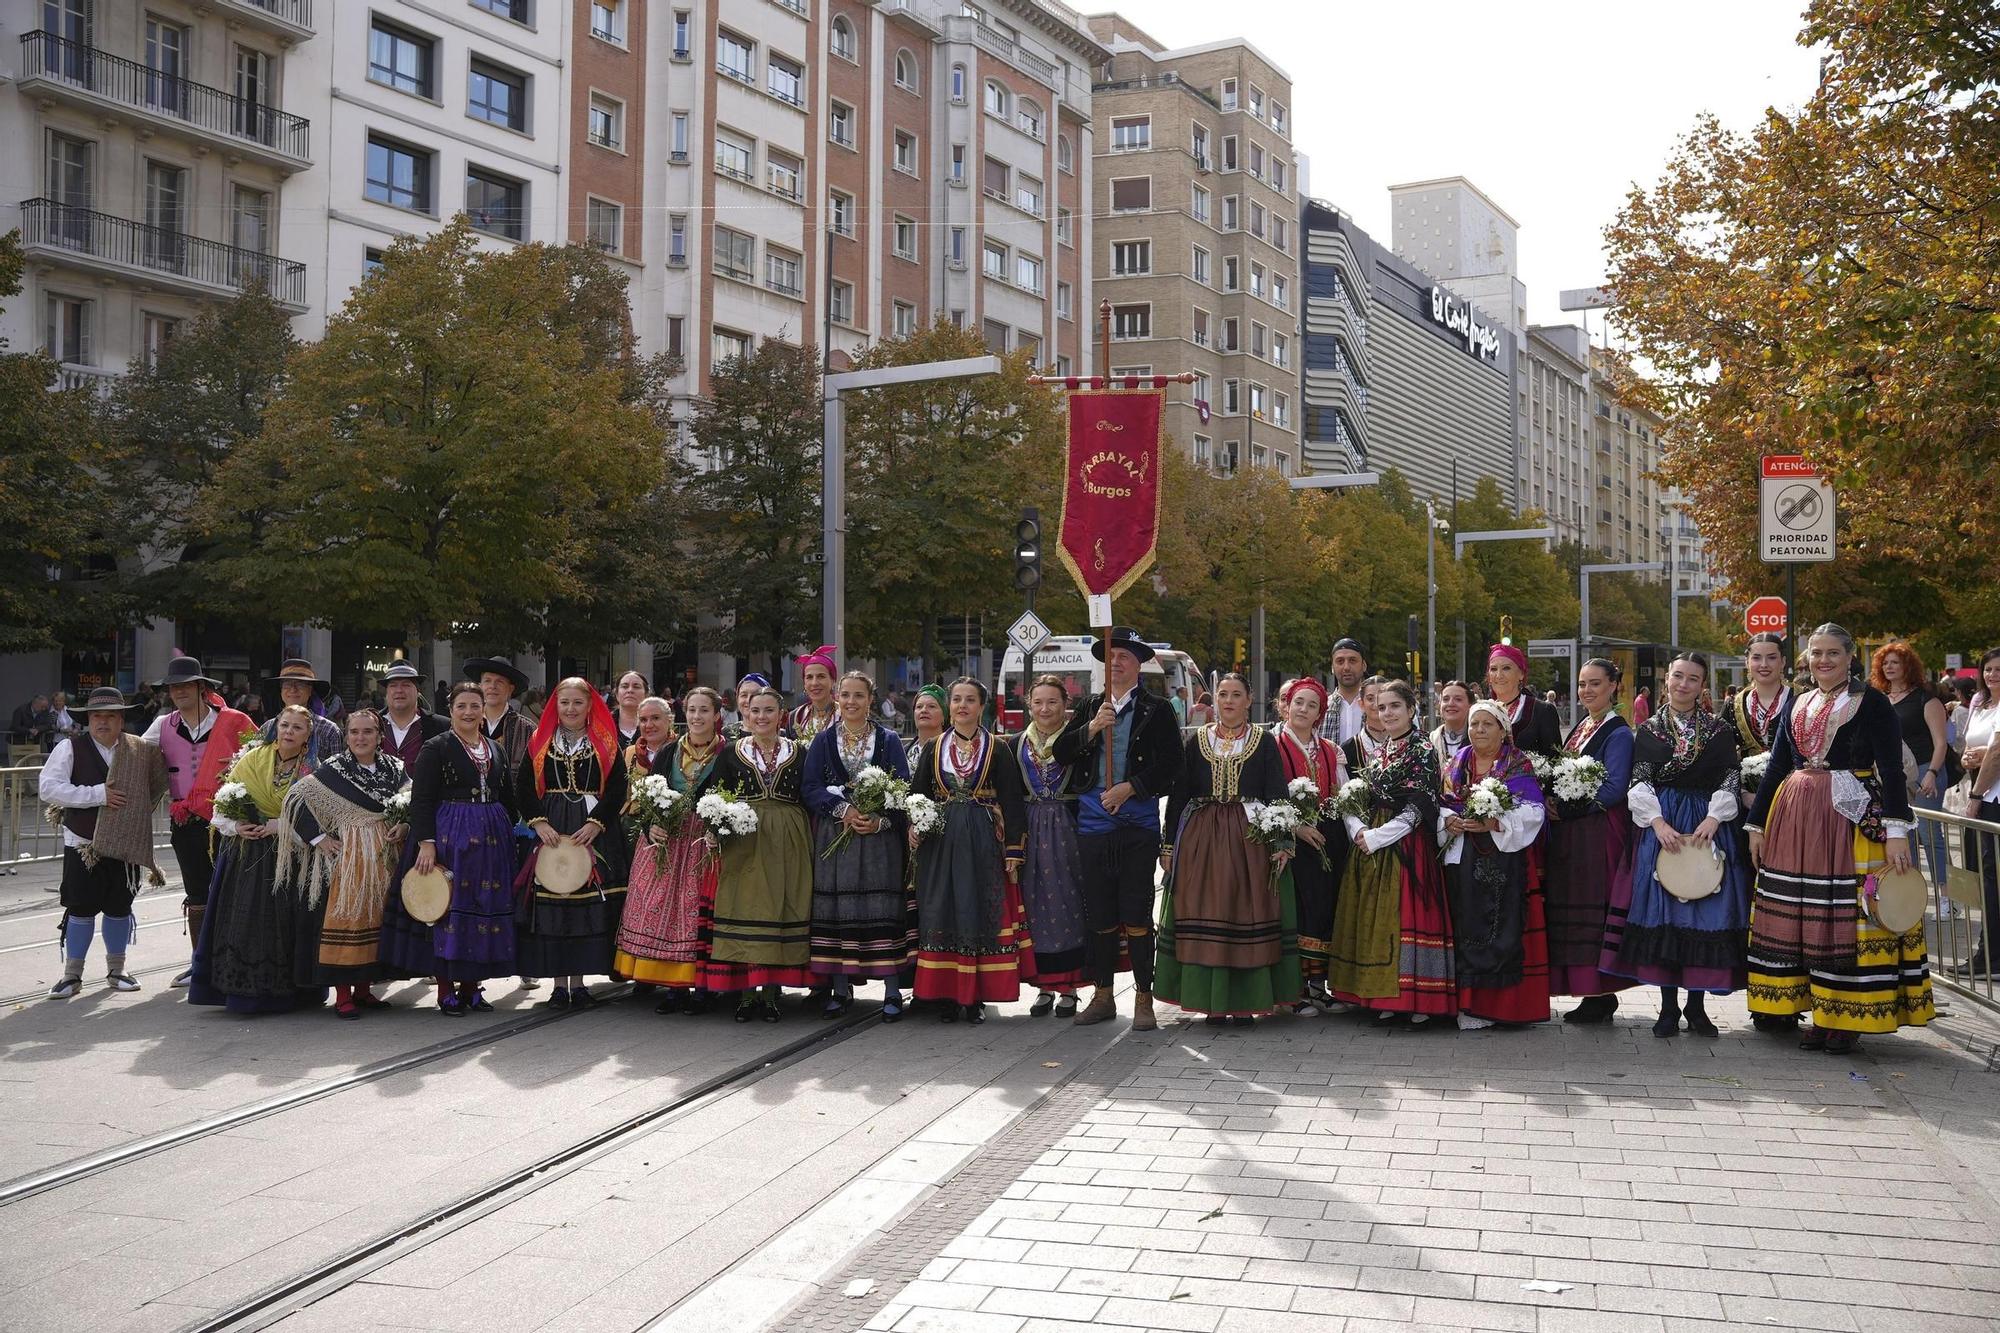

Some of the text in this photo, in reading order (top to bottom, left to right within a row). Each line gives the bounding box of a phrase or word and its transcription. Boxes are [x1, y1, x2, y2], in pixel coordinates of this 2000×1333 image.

[1086, 451, 1138, 478] ARBAYAL
[1088, 482, 1131, 498] Burgos
[1769, 534, 1828, 543] PRIORIDAD
[1770, 546, 1827, 555] PEATONAL
[1019, 624, 1038, 640] 30
[1015, 654, 1083, 664] ABULANCIA
